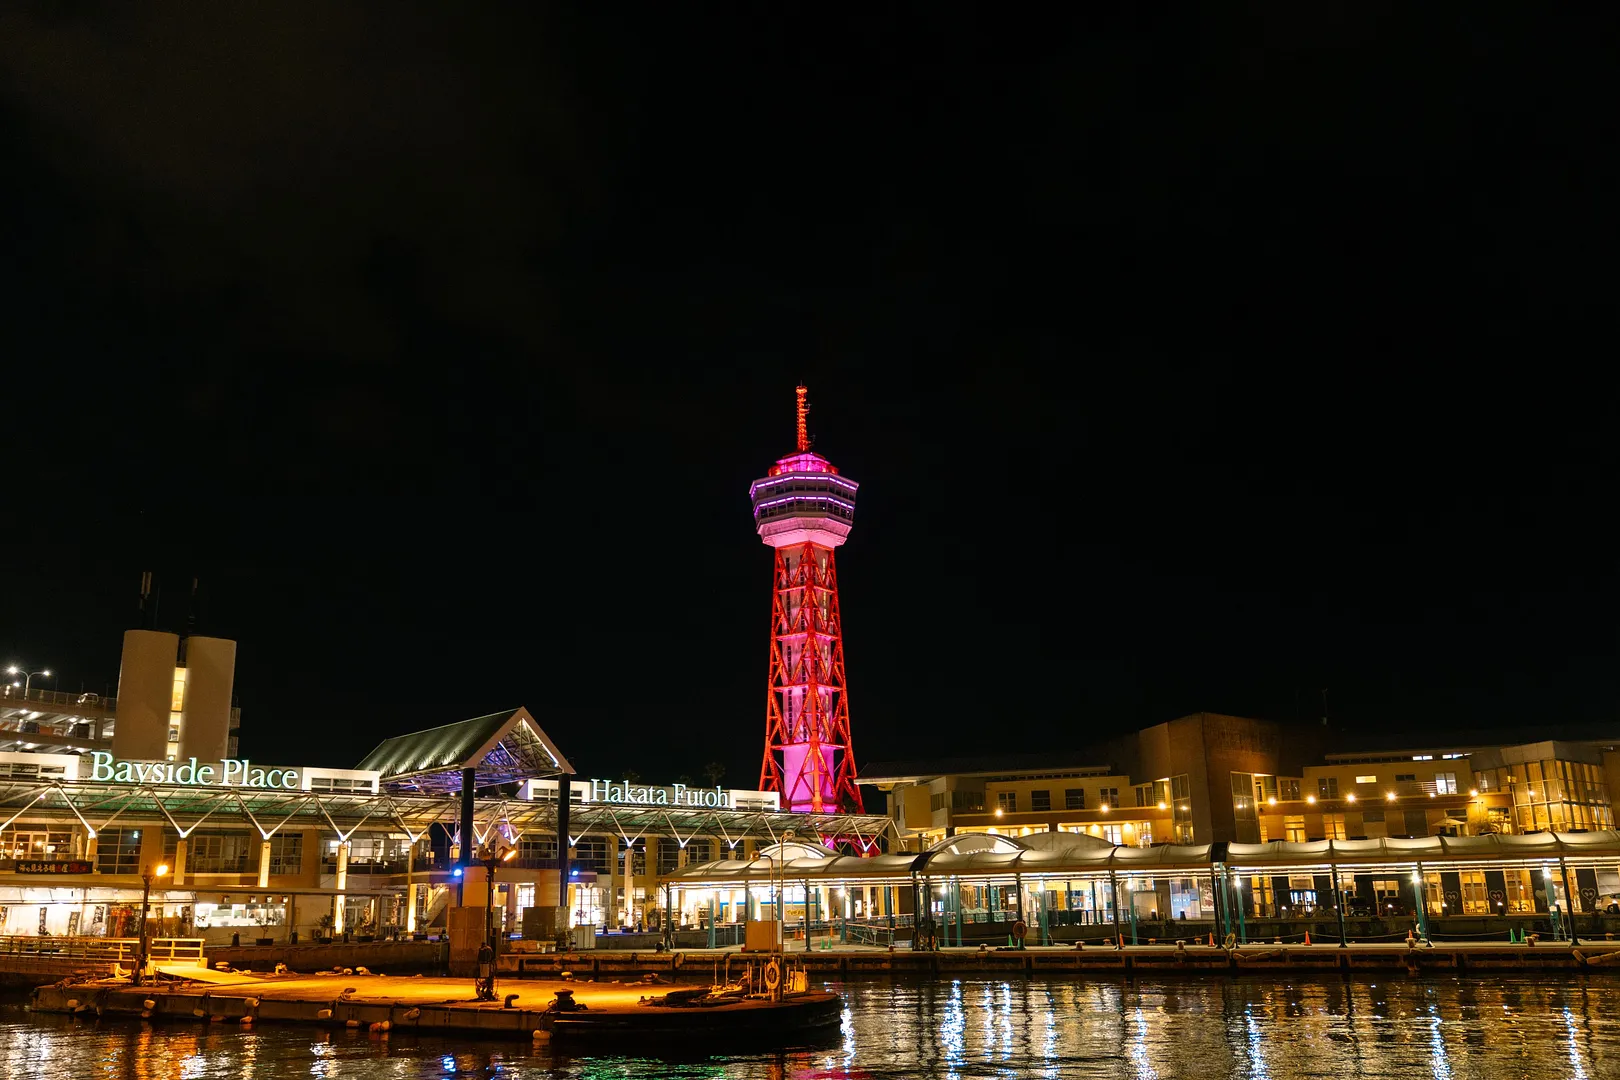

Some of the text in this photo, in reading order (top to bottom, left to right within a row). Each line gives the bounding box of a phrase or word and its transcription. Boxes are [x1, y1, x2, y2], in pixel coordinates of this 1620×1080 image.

[90, 751, 299, 789] Bayside Place
[590, 778, 729, 808] Hakata Futoh
